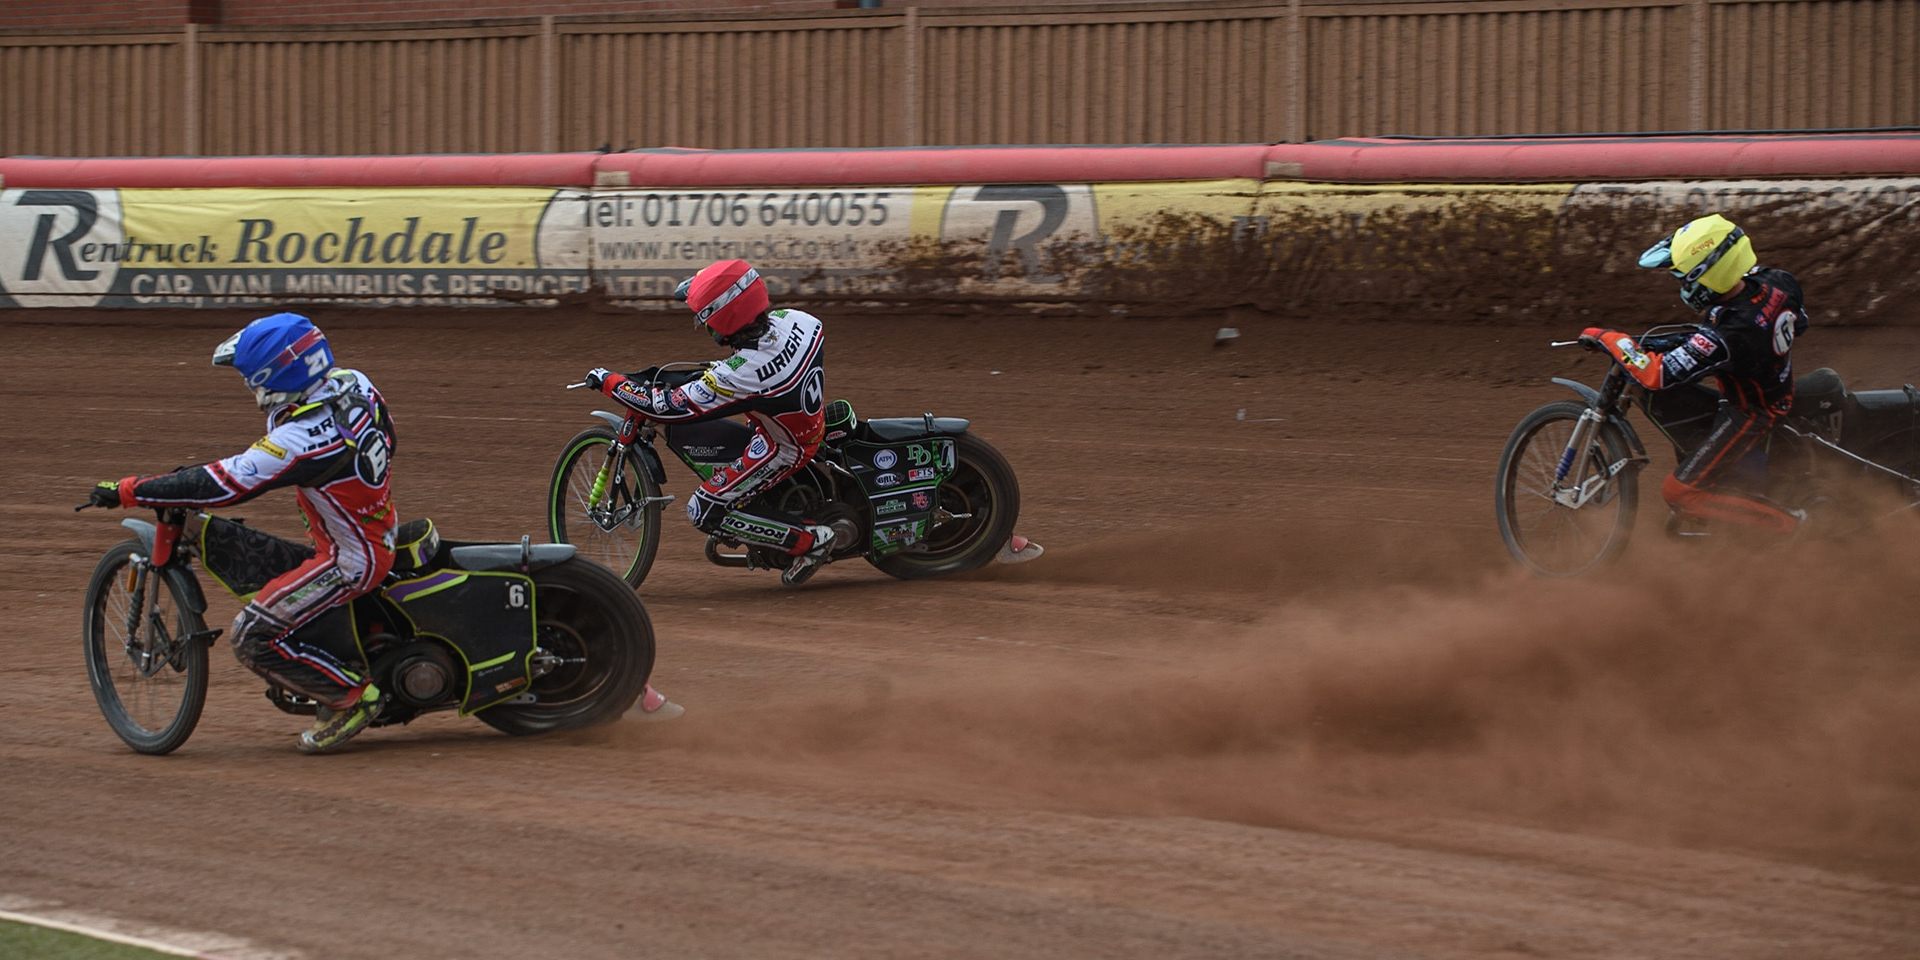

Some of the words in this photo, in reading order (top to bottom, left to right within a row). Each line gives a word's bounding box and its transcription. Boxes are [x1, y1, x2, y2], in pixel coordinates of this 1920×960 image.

[643, 194, 748, 227] 01706
[759, 192, 890, 226] 640055
[15, 190, 217, 281] Rentruck
[229, 217, 507, 264] Rochdale
[755, 322, 805, 382] WRIGHT
[744, 524, 786, 539] ROCK
[509, 584, 525, 608] 6
